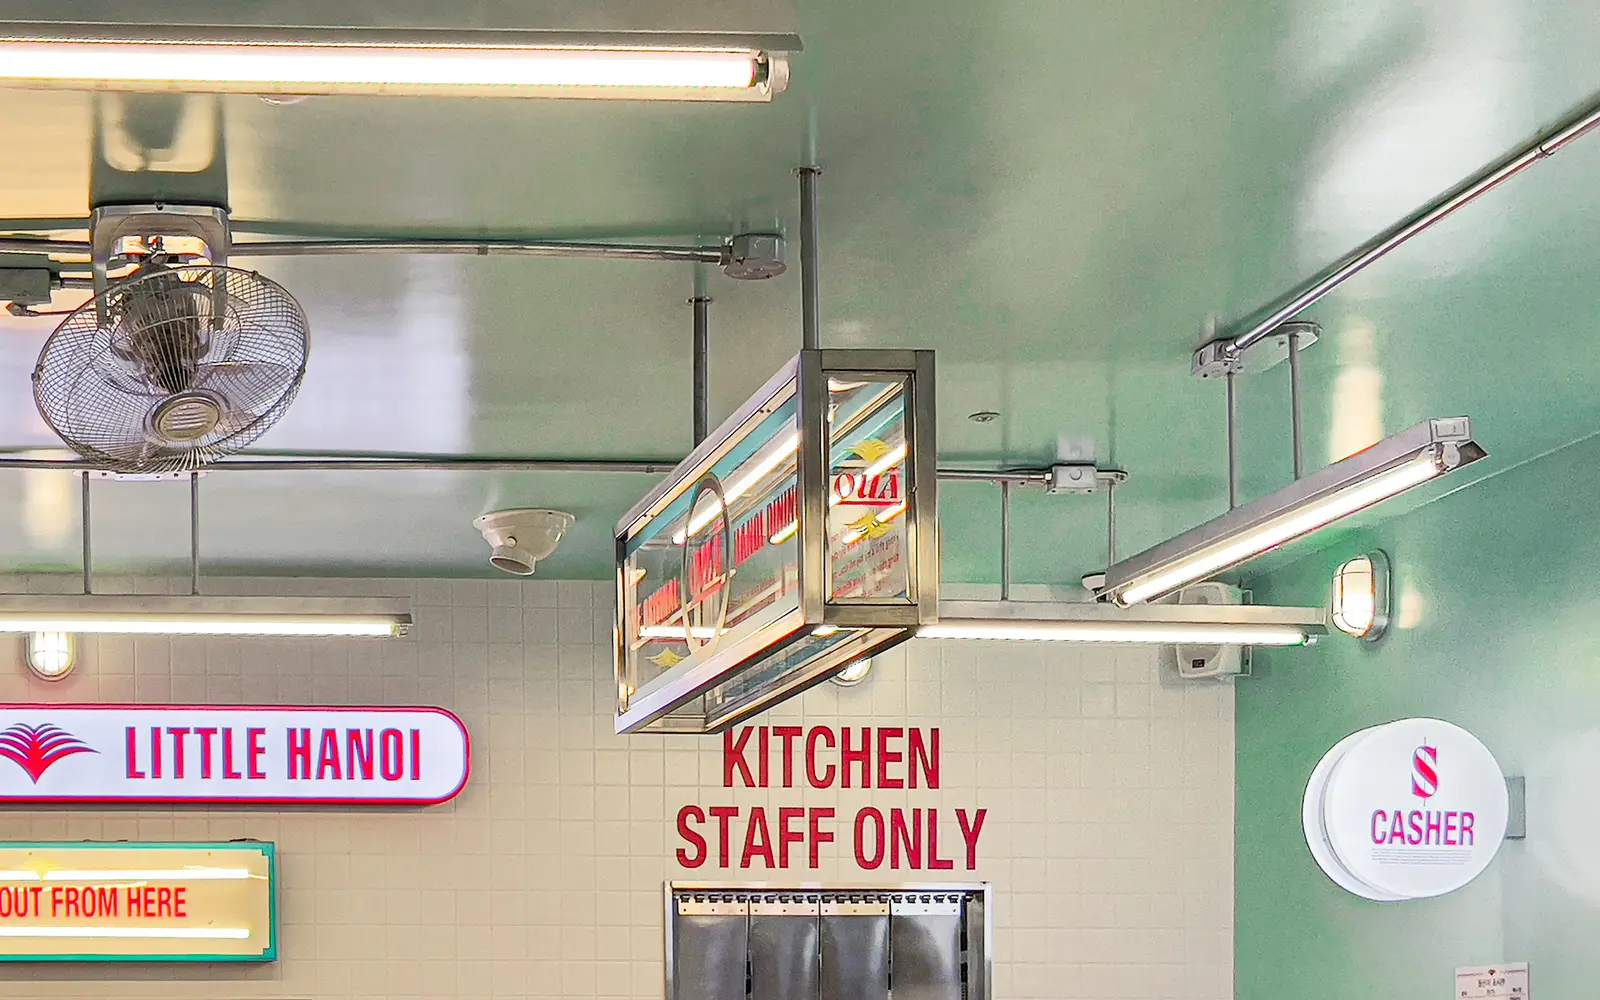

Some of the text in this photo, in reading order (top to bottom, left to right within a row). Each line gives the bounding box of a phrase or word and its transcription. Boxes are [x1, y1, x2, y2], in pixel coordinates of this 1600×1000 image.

[126, 726, 421, 781] LITTLE HANOI
[723, 725, 940, 790] KITCHEN
[675, 804, 988, 871] STAFF ONLY
[1371, 809, 1475, 846] CASHER
[0, 885, 188, 919] OUT FROM HERE
